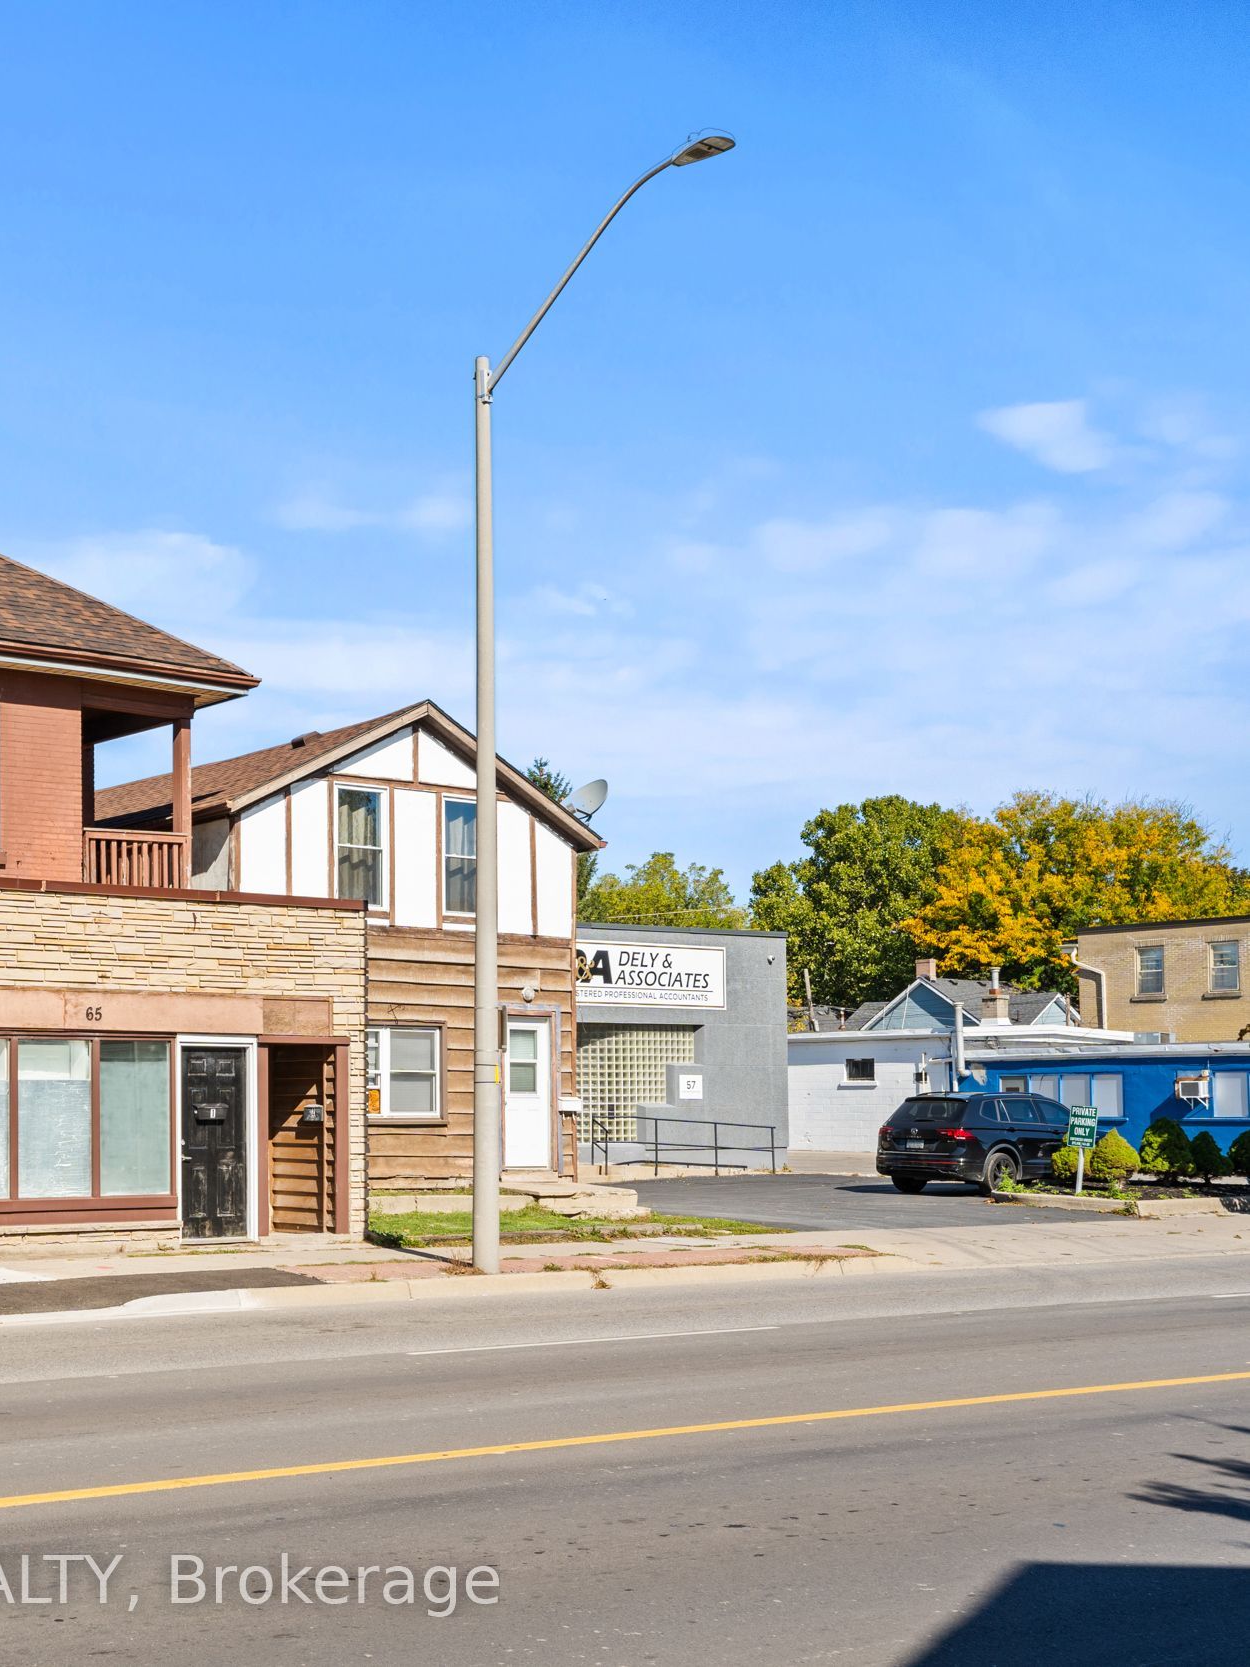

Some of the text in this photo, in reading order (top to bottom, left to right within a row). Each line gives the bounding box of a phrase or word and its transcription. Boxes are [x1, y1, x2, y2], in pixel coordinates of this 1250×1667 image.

[618, 951, 673, 969] DELY &
[614, 969, 710, 989] ASSOCIATES
[604, 990, 657, 1000] PROFESSIONAL
[659, 992, 709, 1002] ACCOUNTANTS
[85, 1006, 103, 1021] 65
[686, 1080, 696, 1090] 57
[1072, 1106, 1096, 1116] PRIVATE
[1070, 1116, 1096, 1126] PARKING
[1074, 1127, 1090, 1136] ONLY
